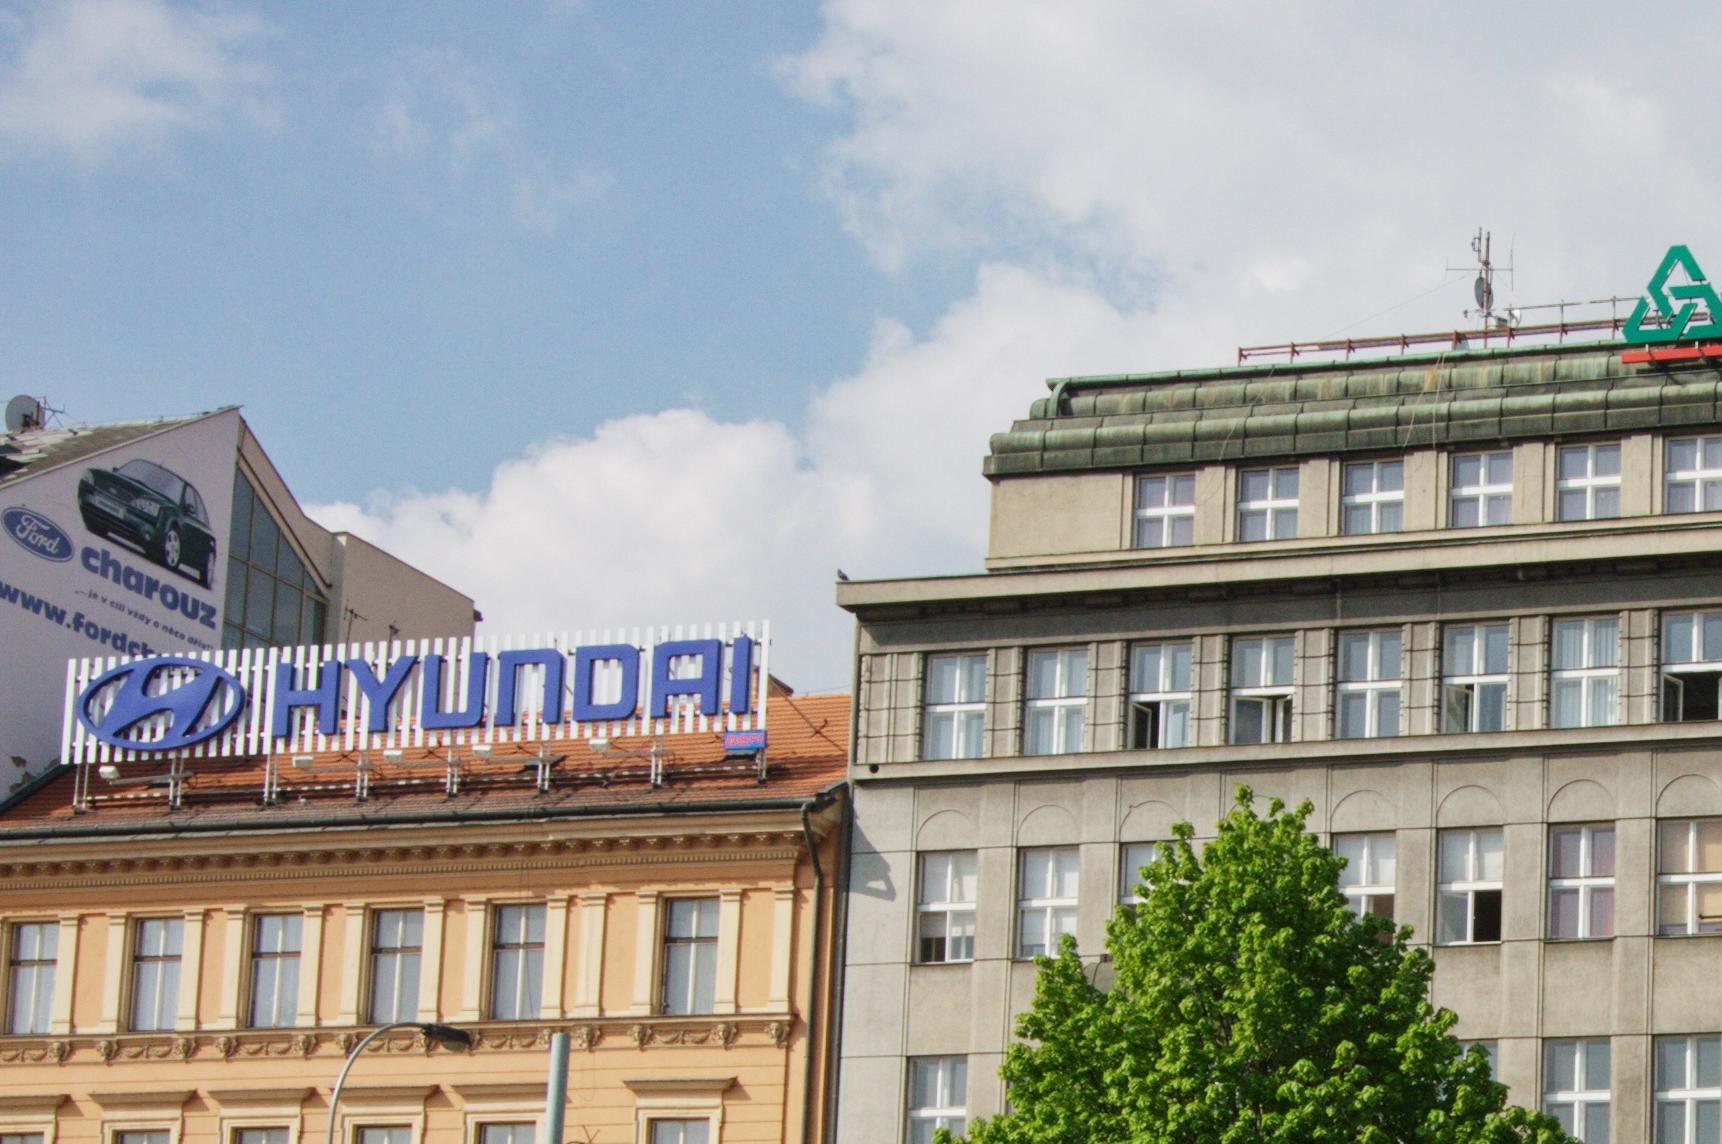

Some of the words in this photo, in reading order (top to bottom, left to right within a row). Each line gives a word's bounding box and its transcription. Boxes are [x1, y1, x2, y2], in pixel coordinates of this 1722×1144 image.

[15, 513, 61, 554] Ford
[0, 581, 164, 661] www.fordch
[80, 545, 218, 631] charouz
[271, 636, 753, 738] HYUNDAI
